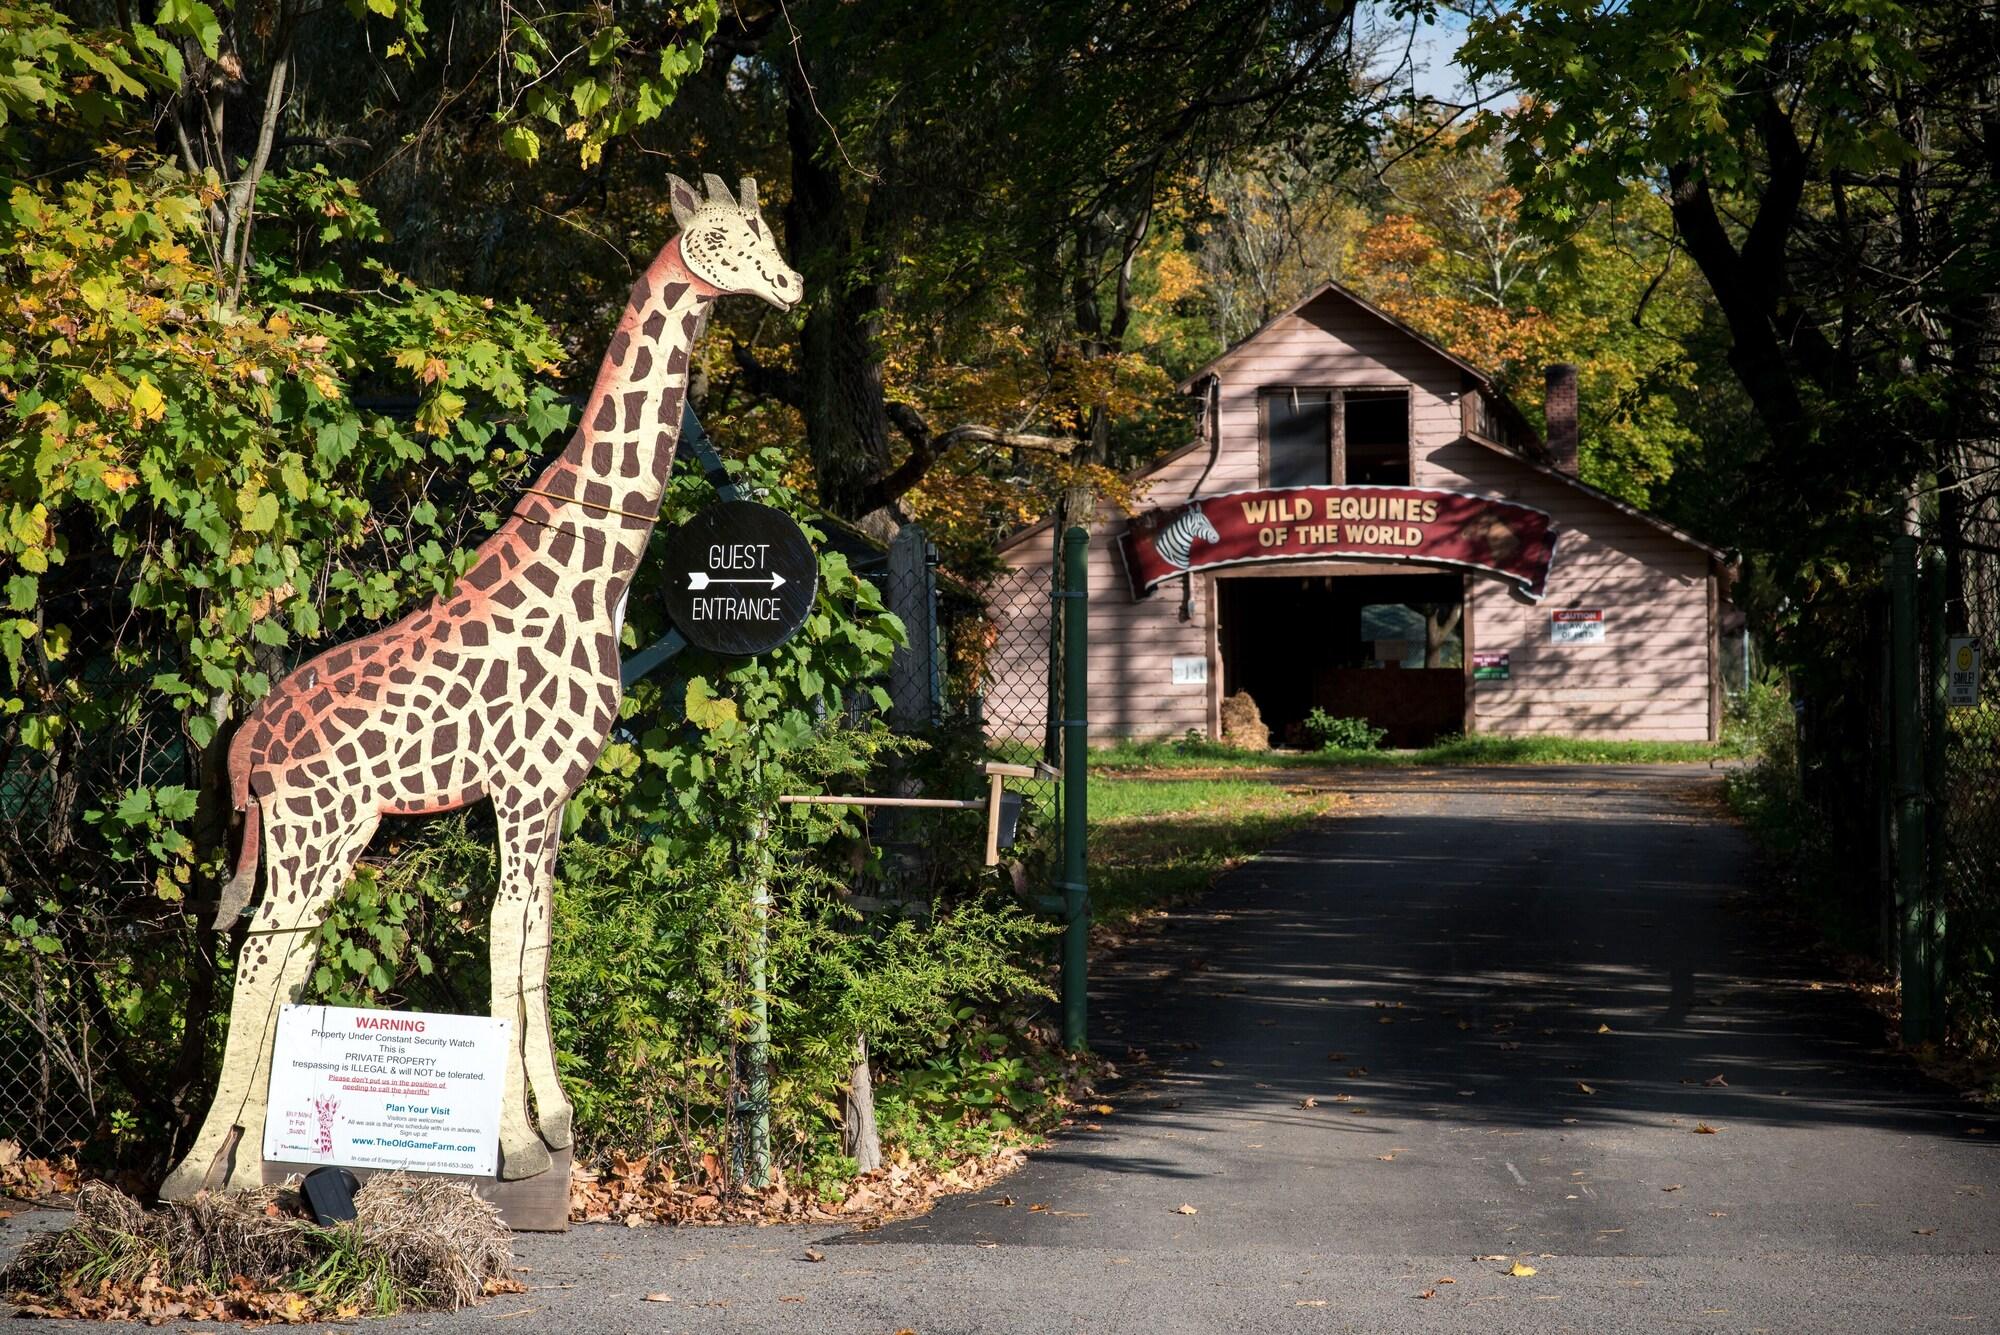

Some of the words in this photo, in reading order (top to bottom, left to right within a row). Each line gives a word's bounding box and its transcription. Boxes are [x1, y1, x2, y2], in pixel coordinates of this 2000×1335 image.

[1241, 498, 1313, 524] WILD
[1325, 496, 1439, 523] EQUINES
[1258, 527, 1288, 547] OF
[1295, 524, 1339, 544] THE
[1344, 524, 1423, 547] WORLD
[709, 544, 770, 569] GUEST
[692, 597, 781, 621] ENTRANCE
[1558, 612, 1596, 620] CAUTION
[356, 1017, 425, 1032] WARNING
[311, 1029, 346, 1040] Property
[348, 1032, 373, 1041] Under
[375, 1034, 412, 1044] Constant
[414, 1036, 447, 1048] Security
[449, 1039, 475, 1048] Watch
[379, 1044, 397, 1053] This
[398, 1046, 406, 1054] is
[345, 1052, 384, 1063] PRIVATE
[386, 1055, 437, 1066] PROPERTY
[292, 1060, 340, 1072] trespassing
[341, 1063, 349, 1071] is
[351, 1064, 388, 1074] ILLEGAL
[390, 1066, 397, 1075] &
[399, 1067, 412, 1076] will
[413, 1068, 434, 1077] NOT
[435, 1069, 446, 1078] be
[448, 1070, 486, 1080] tolerated.
[328, 1074, 350, 1082] Please
[351, 1075, 368, 1084] don't
[411, 1081, 438, 1089] position
[342, 1084, 369, 1092] needing
[403, 1088, 430, 1096] sheriffs!
[386, 1103, 405, 1112] Plan
[408, 1105, 428, 1114] Your
[431, 1106, 450, 1115] Visit
[387, 1114, 407, 1122] Visitors
[399, 1129, 412, 1137] Sign
[352, 1137, 476, 1152] www.TheOldGameFarm.com
[378, 1156, 407, 1166] Emergency
